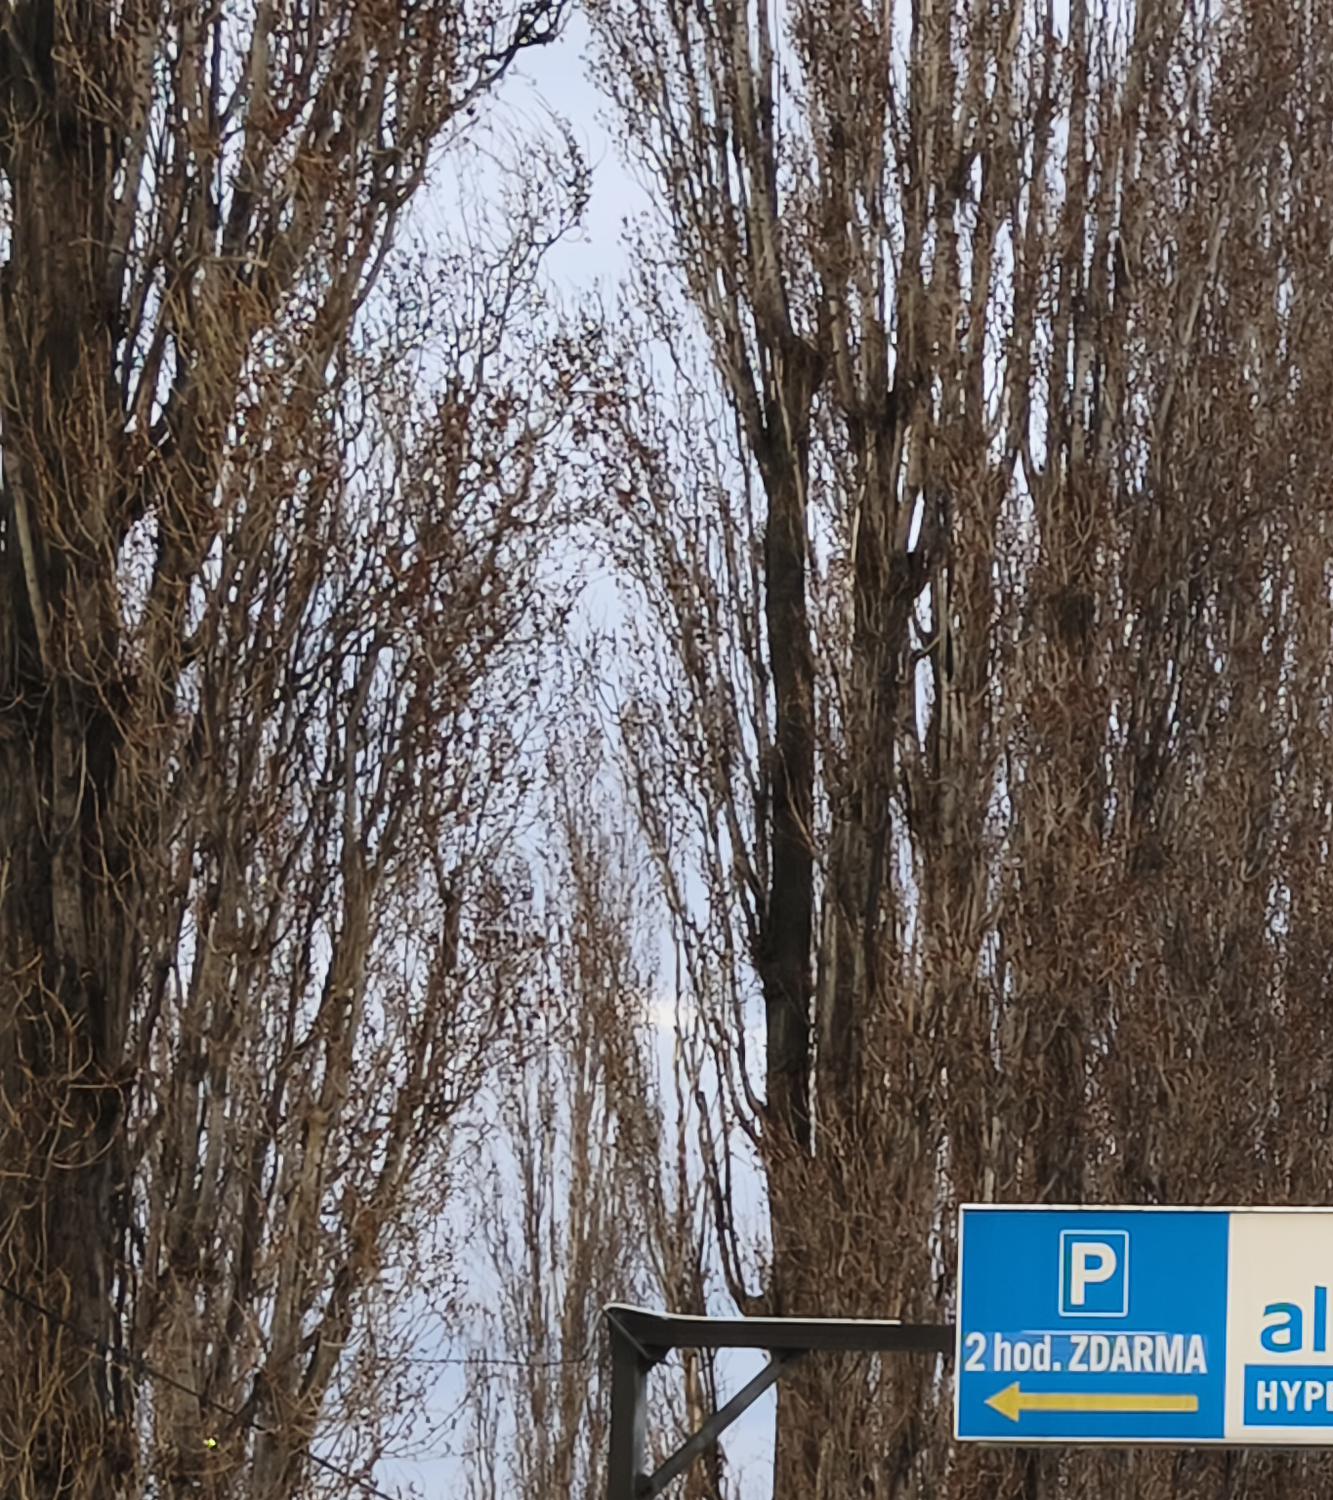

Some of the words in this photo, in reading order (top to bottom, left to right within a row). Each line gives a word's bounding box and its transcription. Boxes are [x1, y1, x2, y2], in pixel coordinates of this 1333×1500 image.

[1070, 1241, 1118, 1306] P
[964, 1332, 985, 1373] 2
[993, 1333, 1062, 1373] hod.
[1069, 1334, 1208, 1375] ZDARMA
